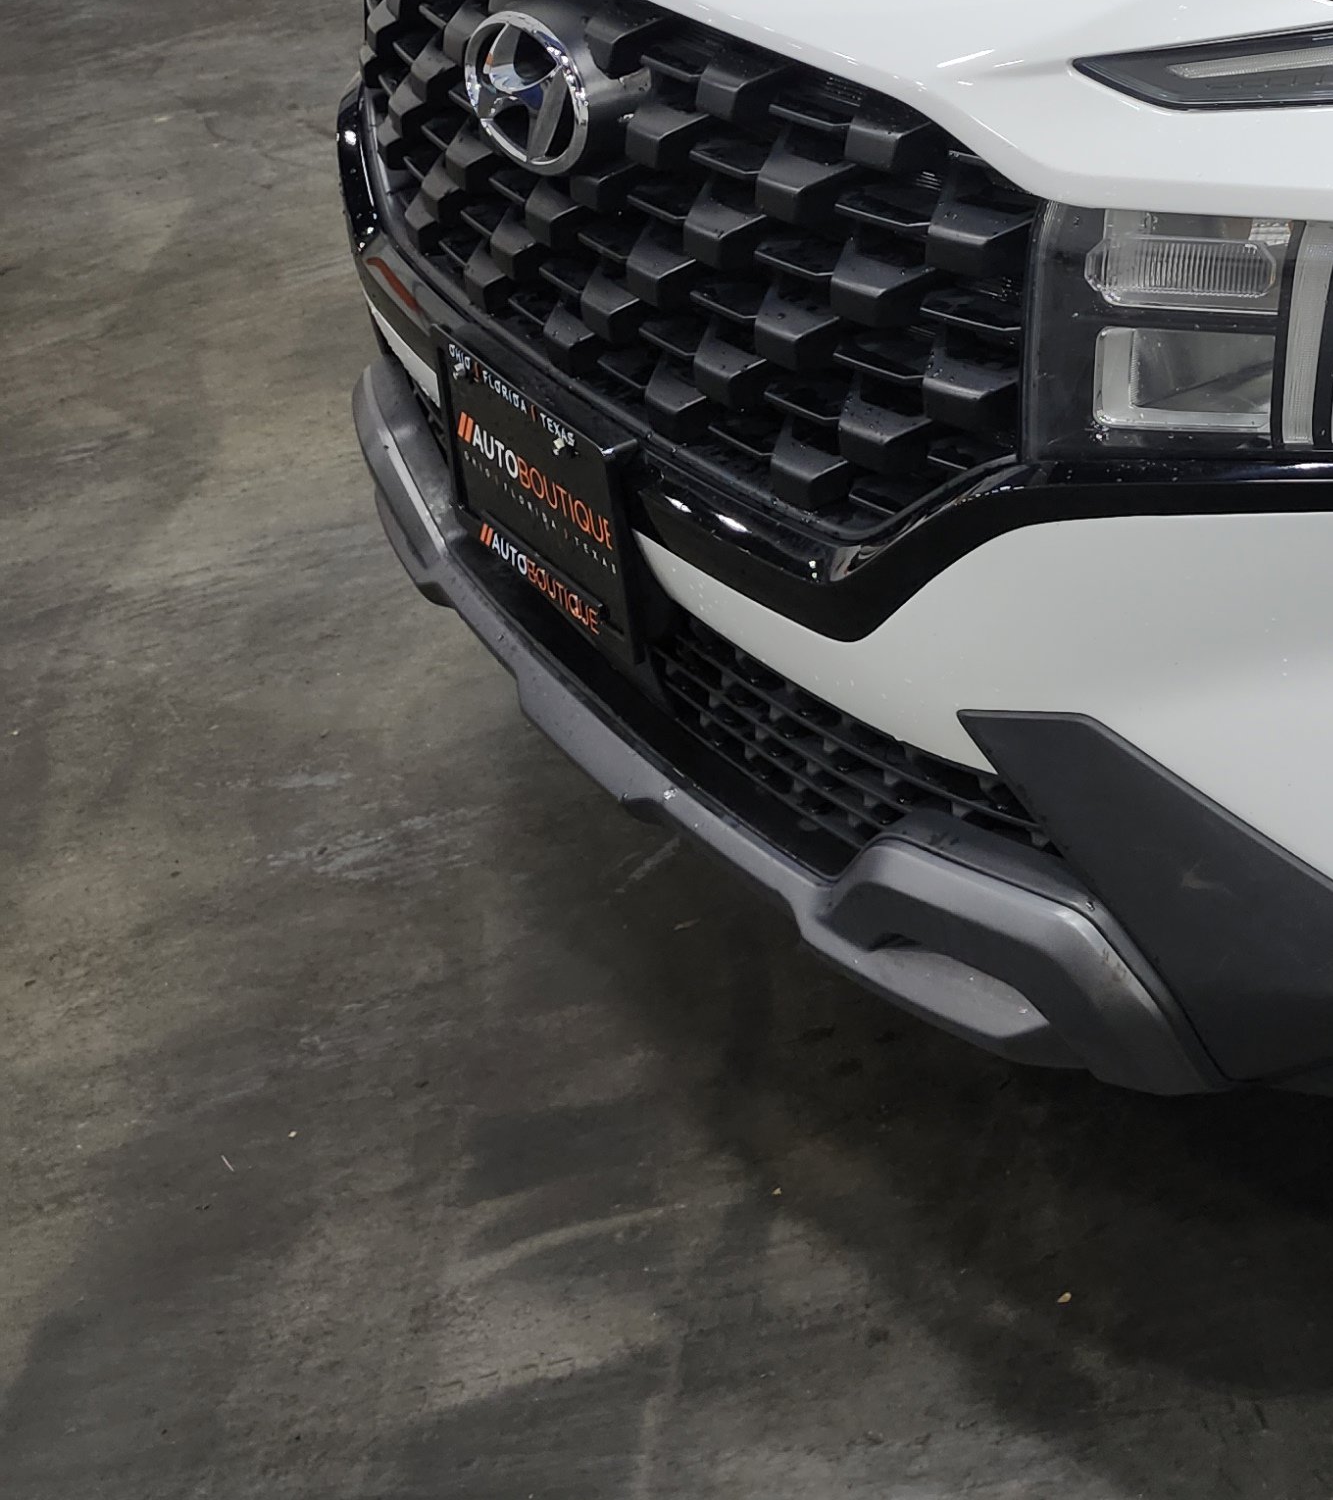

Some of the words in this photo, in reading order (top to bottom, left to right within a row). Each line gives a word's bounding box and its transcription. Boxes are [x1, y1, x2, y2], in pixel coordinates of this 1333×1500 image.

[482, 370, 527, 414] FLORIDA
[540, 412, 576, 447] TEXAS
[472, 424, 613, 551] AUTOBOUTIQUE
[491, 533, 601, 635] AUTOBOUTIQUE
